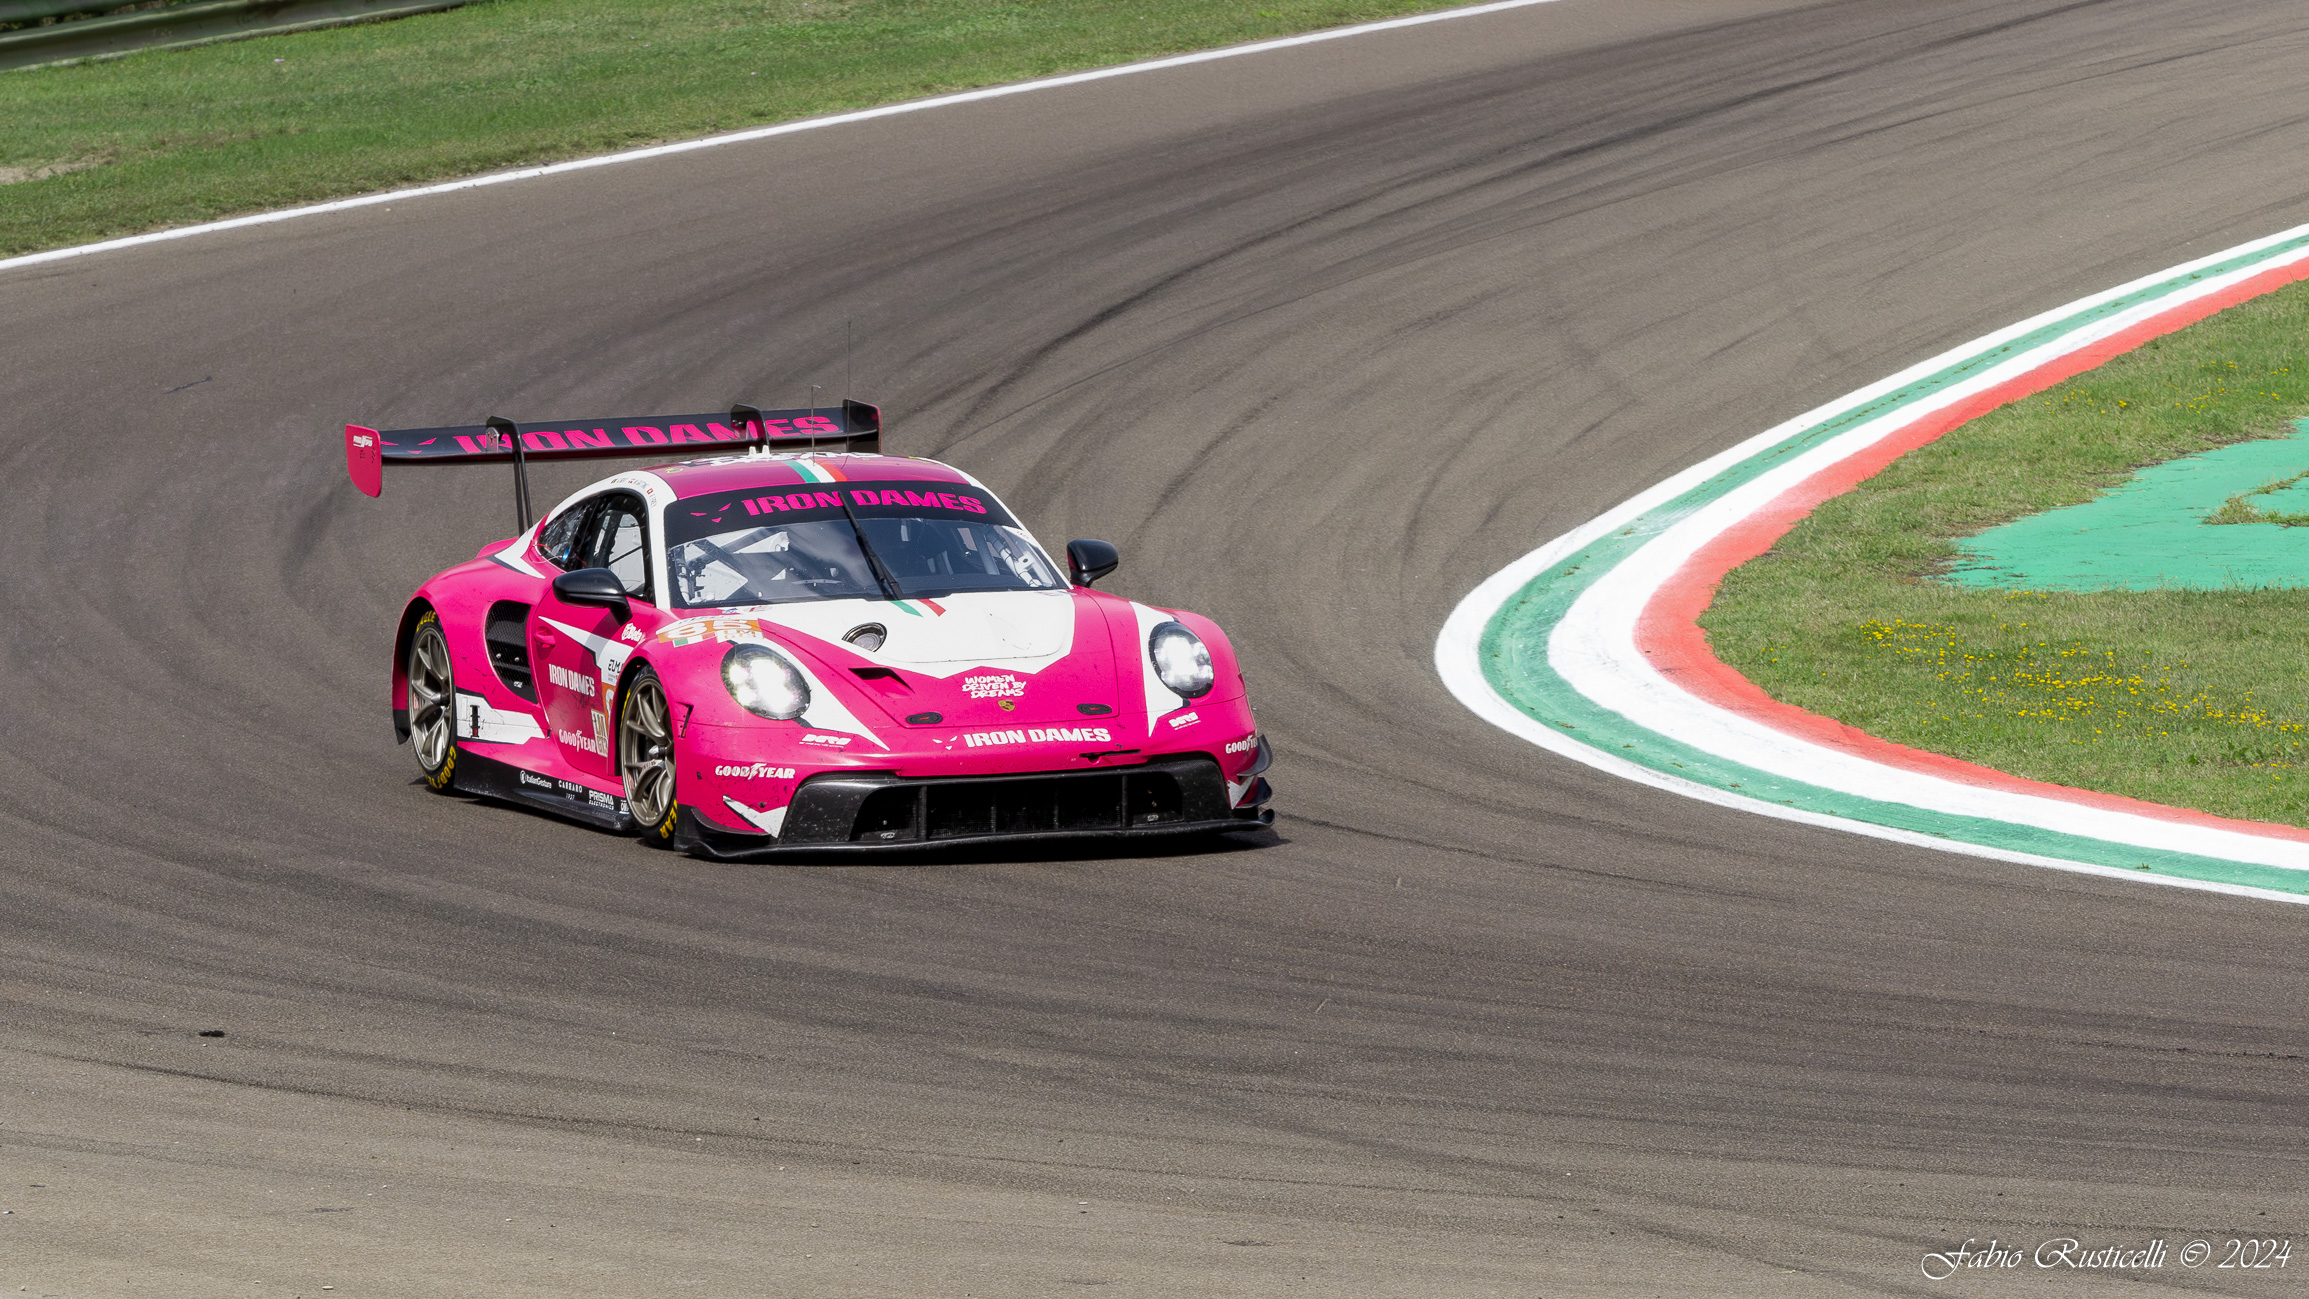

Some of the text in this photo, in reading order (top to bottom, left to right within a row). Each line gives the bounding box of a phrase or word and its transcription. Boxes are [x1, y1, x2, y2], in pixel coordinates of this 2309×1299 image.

[622, 416, 839, 446] DAMES
[742, 490, 987, 516] IRON DAMES
[549, 664, 568, 688] IRON
[568, 670, 596, 697] DAMES
[962, 681, 1027, 691] DRIVEN BY
[964, 674, 1015, 684] WOMEN
[970, 688, 1024, 699] DREAMS
[559, 729, 597, 752] GOODYEAR
[963, 728, 1111, 747] IRON DAMES
[715, 763, 796, 780] GOODYEAR
[588, 790, 614, 805] PRISMA
